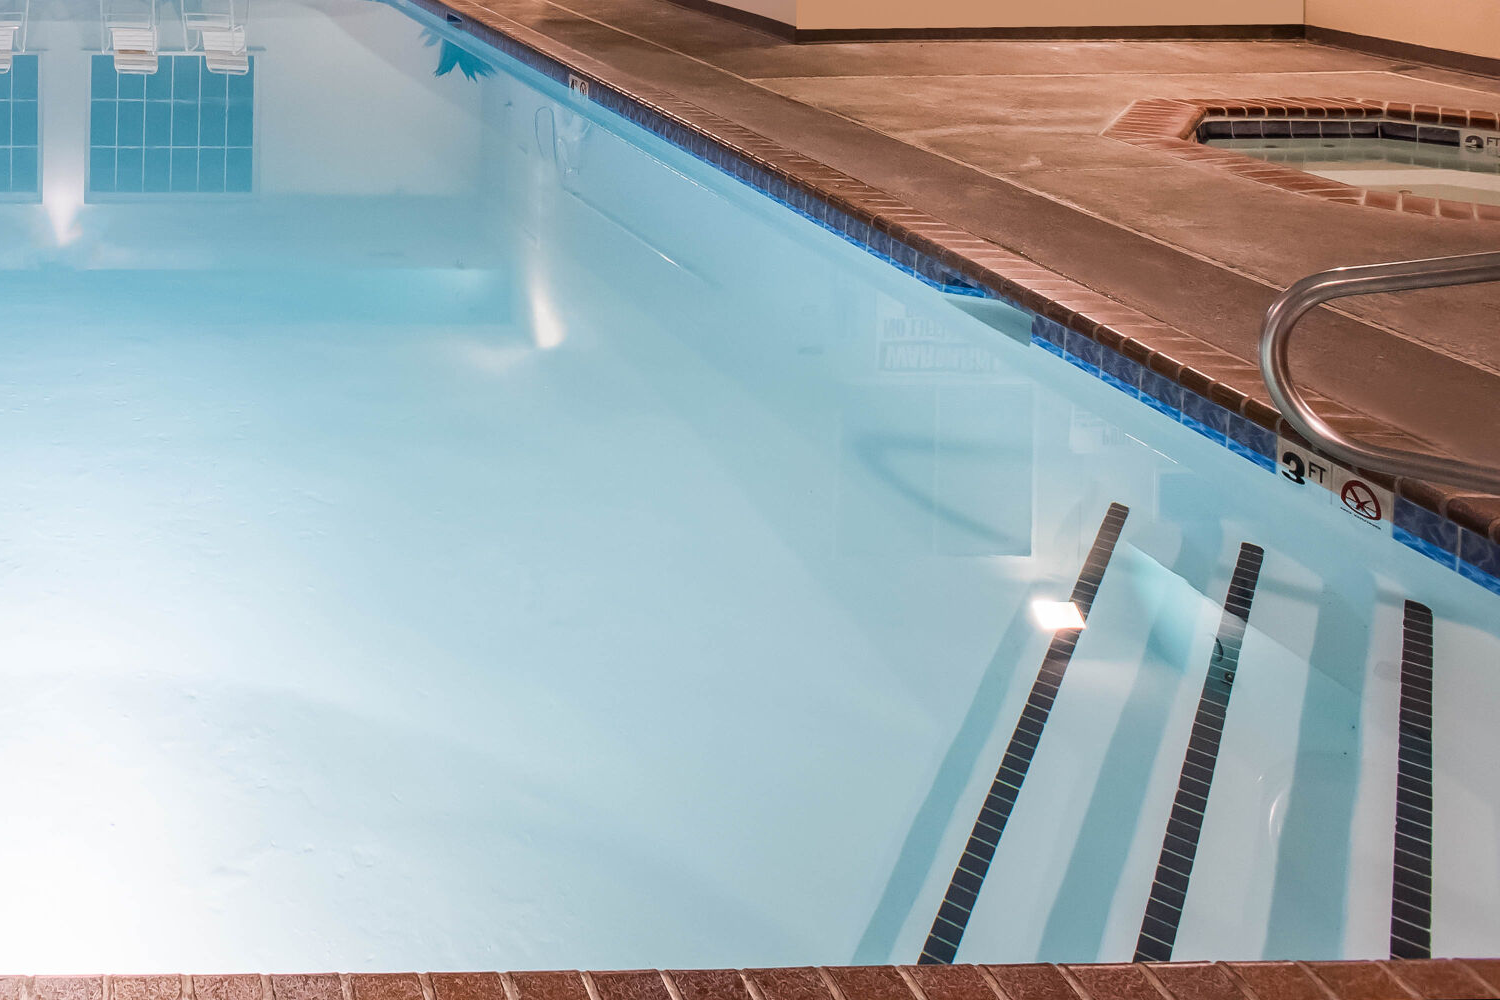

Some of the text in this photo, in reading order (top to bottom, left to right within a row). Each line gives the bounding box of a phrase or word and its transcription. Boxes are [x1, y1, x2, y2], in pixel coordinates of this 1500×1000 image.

[1486, 136, 1500, 147] FT
[1282, 451, 1326, 485] 3 FT
